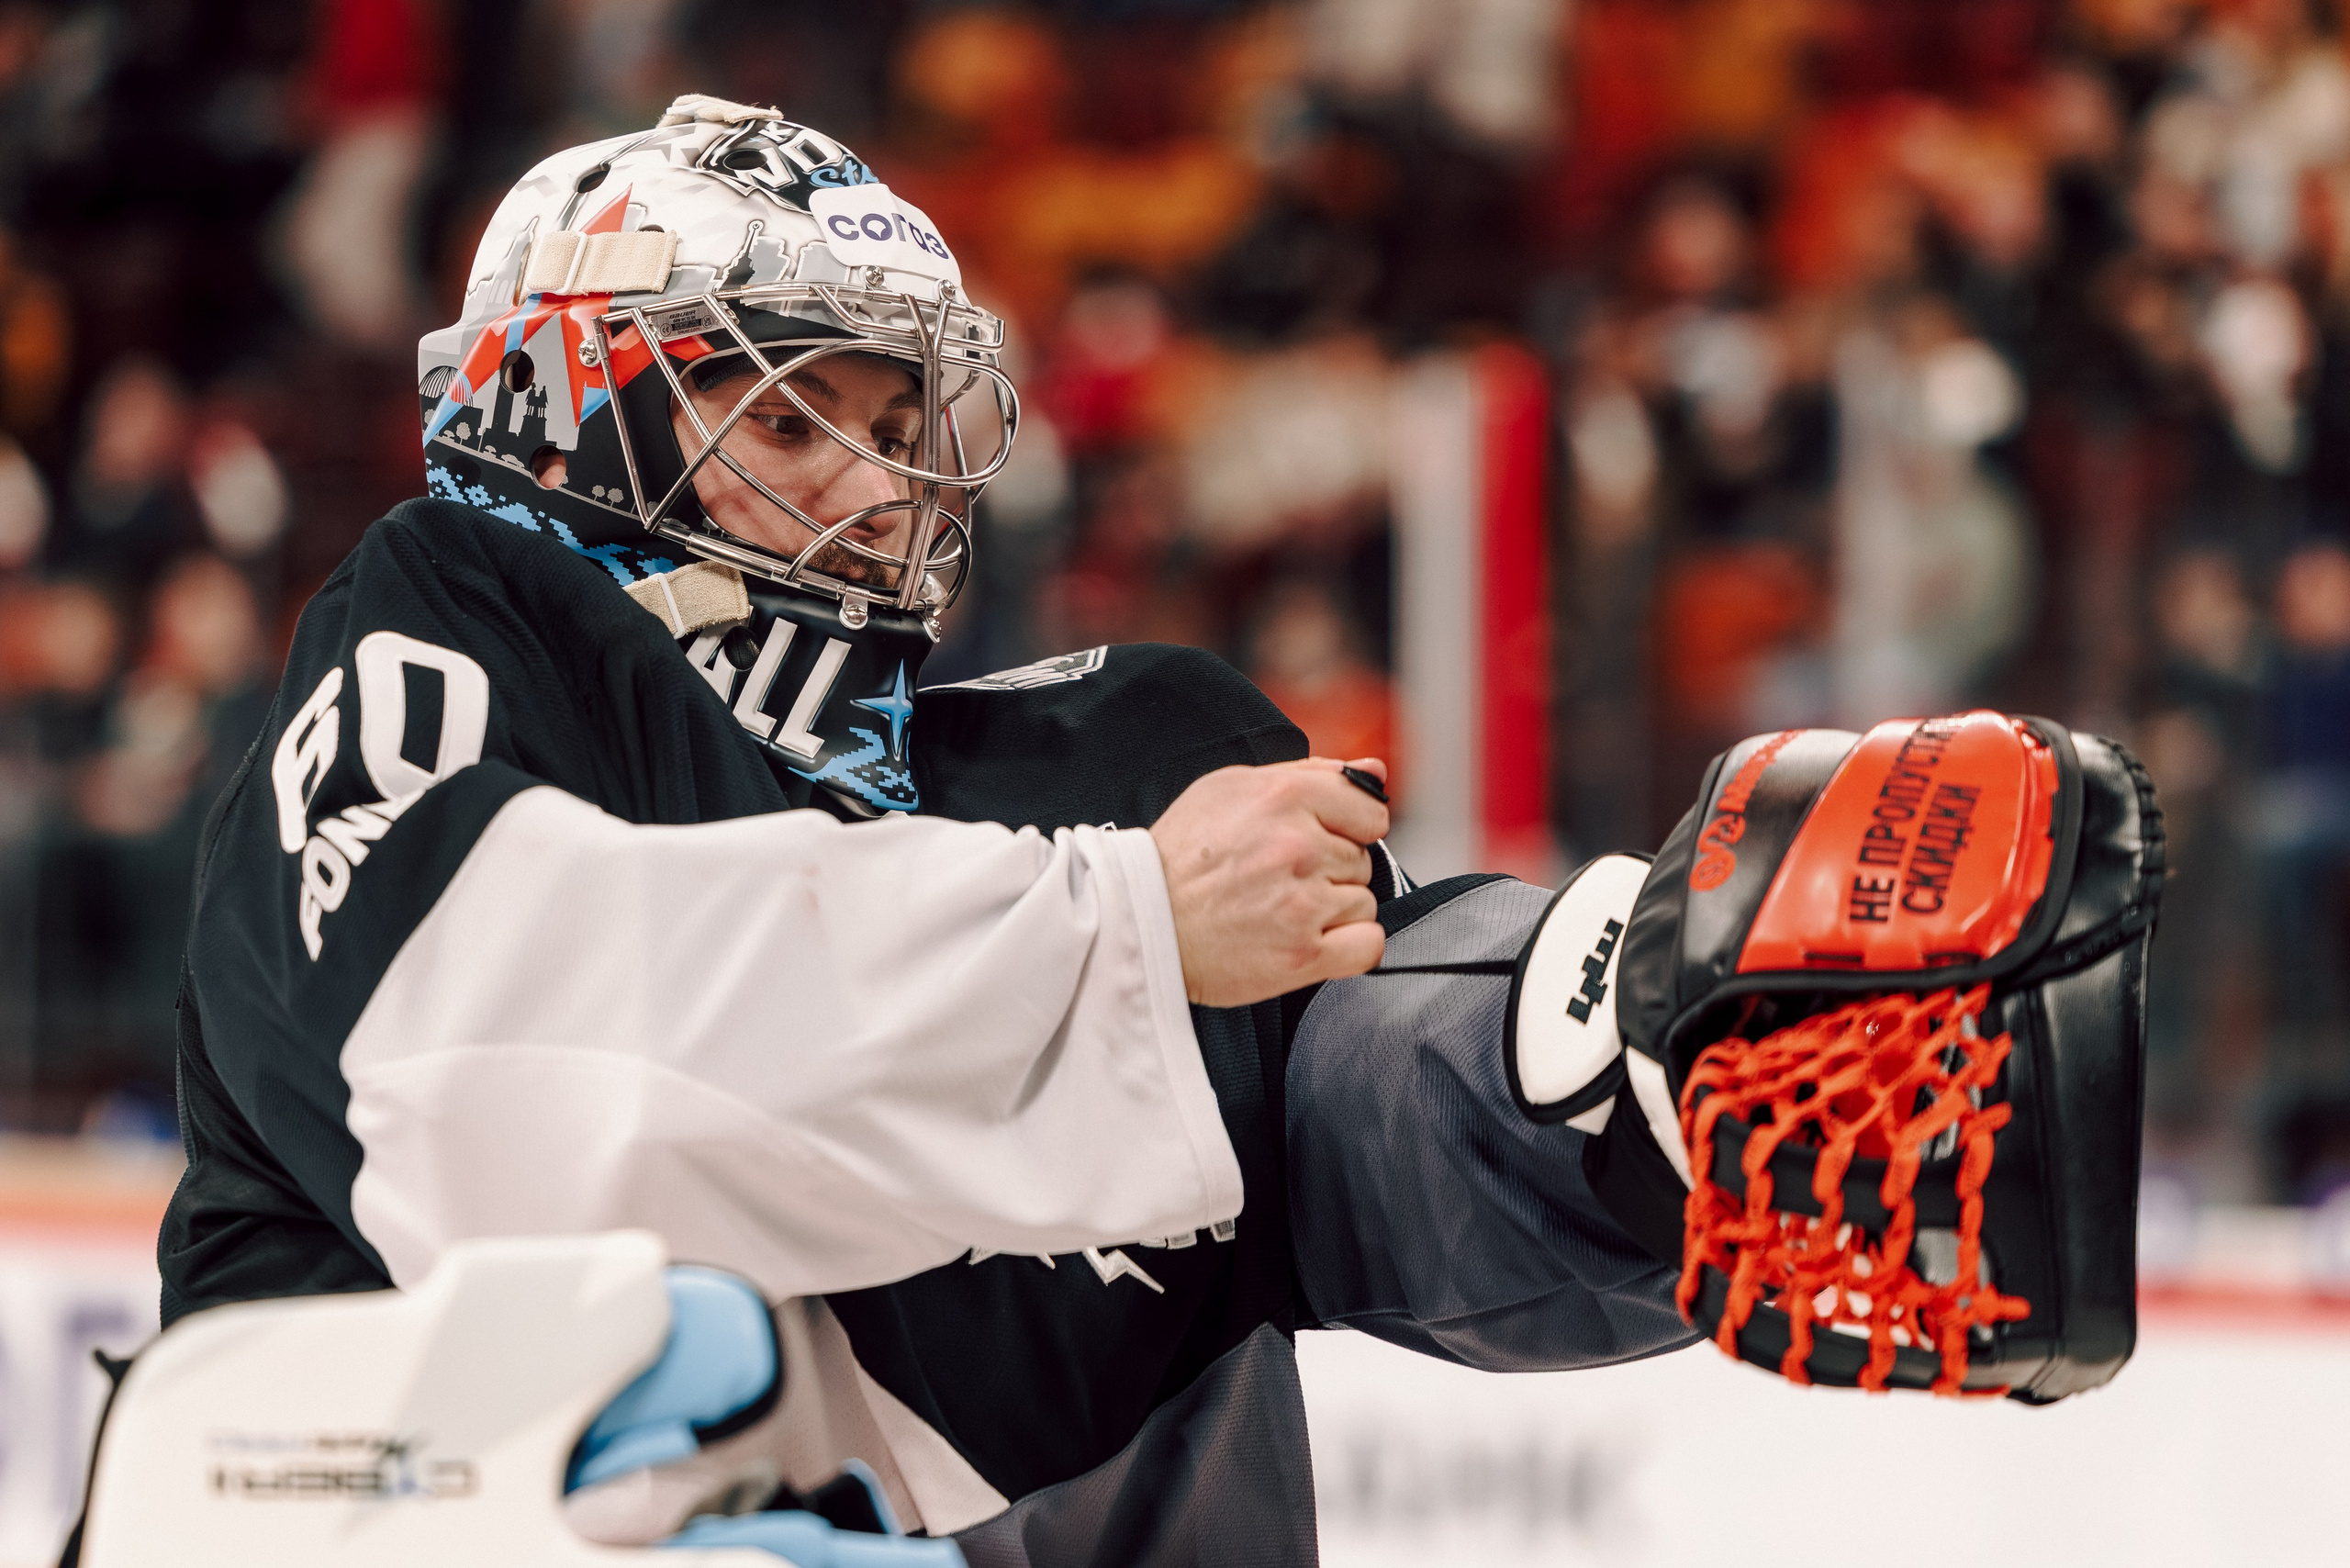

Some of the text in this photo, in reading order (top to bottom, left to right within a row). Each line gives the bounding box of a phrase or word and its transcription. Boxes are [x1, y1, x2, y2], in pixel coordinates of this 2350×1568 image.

[827, 212, 949, 260] согаз
[1902, 783, 1983, 913] СКИДКИ
[1850, 875, 1896, 924] НЕ
